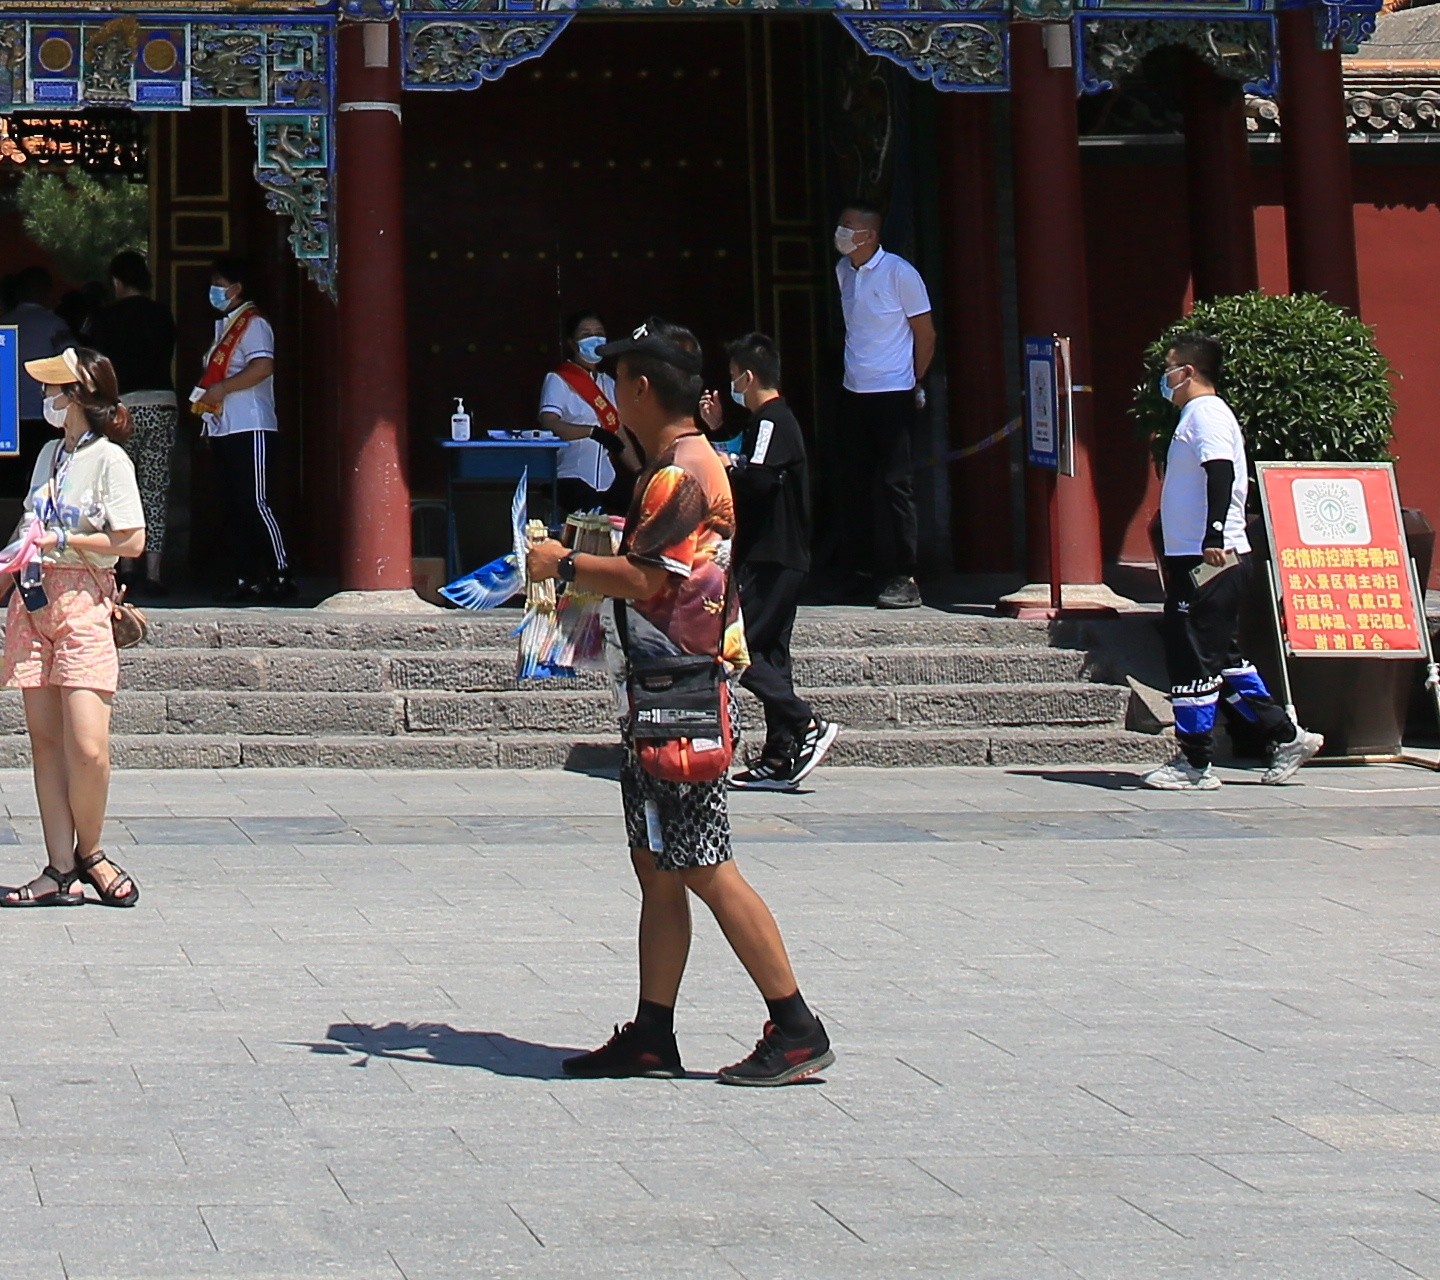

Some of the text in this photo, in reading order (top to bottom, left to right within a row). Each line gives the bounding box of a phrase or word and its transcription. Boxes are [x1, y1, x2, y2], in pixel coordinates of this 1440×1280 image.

[1281, 547, 1400, 569] 疫情防控游客需知
[1288, 573, 1400, 590] 进入景区请主动扫
